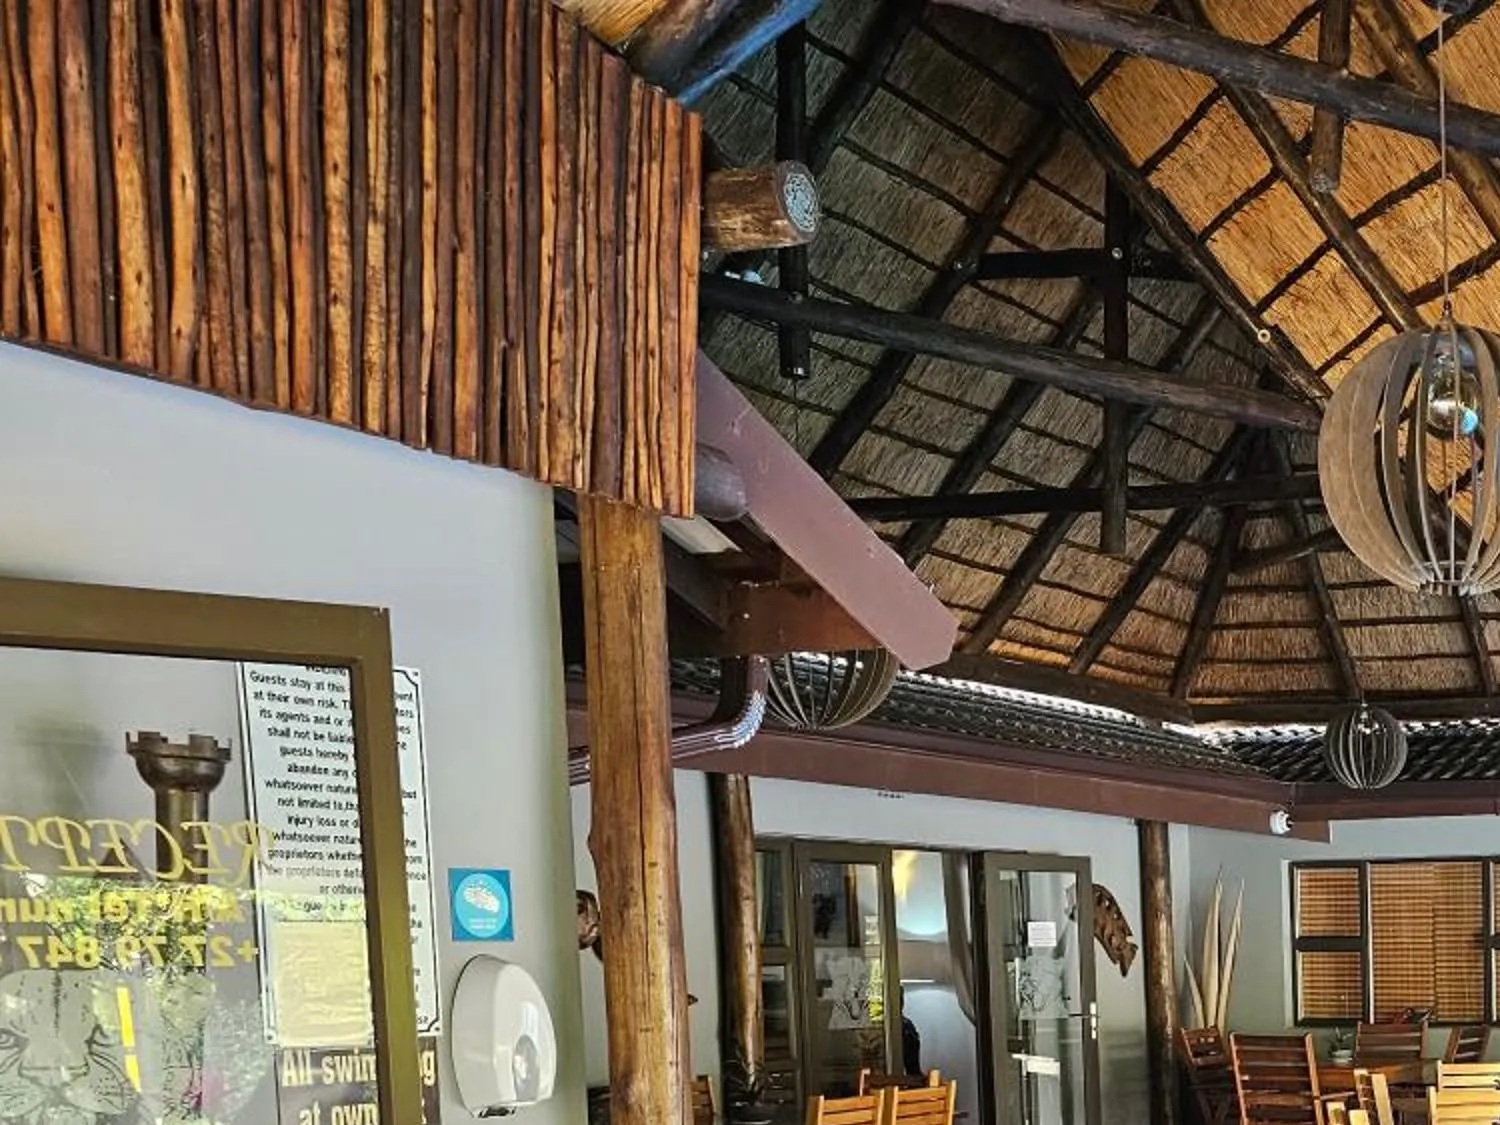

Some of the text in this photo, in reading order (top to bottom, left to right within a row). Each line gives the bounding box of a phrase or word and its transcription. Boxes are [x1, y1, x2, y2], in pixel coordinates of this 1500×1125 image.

[250, 669, 346, 693] Guests stay at this
[253, 690, 264, 700] at
[293, 730, 311, 741] not
[282, 1048, 313, 1087] All
